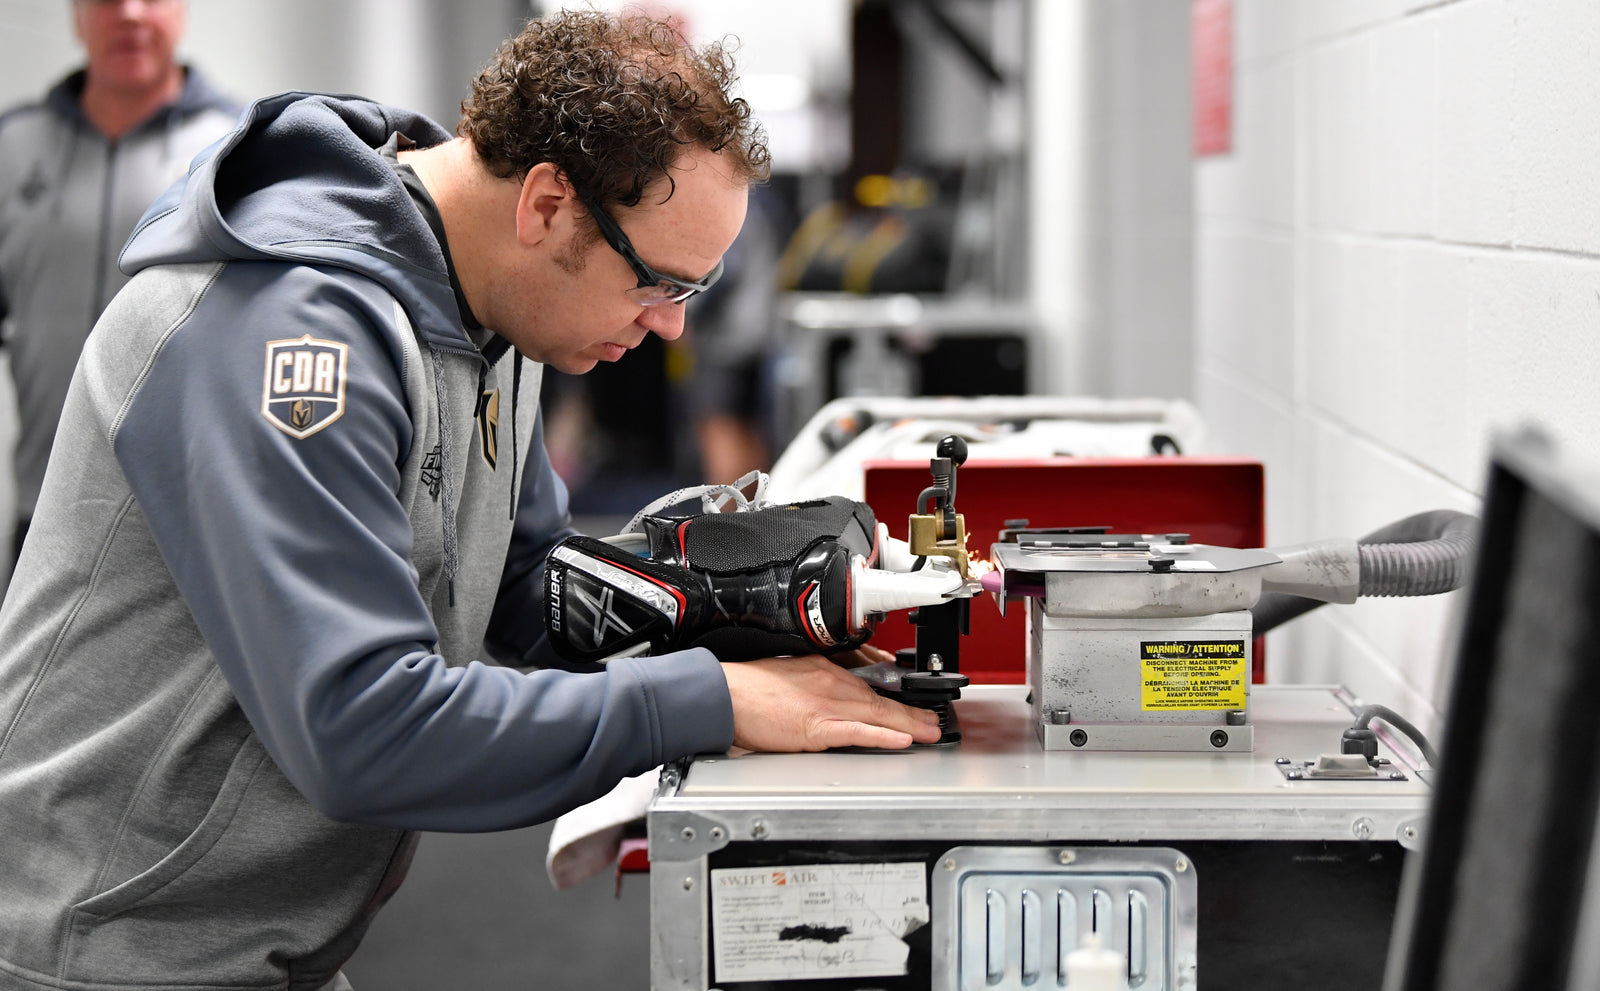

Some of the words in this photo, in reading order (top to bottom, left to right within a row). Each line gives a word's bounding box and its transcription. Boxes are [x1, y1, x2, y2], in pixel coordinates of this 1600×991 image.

[273, 351, 335, 394] CDA
[1145, 645, 1185, 654] WARNING
[1192, 644, 1239, 653] ATTENTION
[720, 874, 767, 886] SWIFT
[790, 872, 818, 883] AIR
